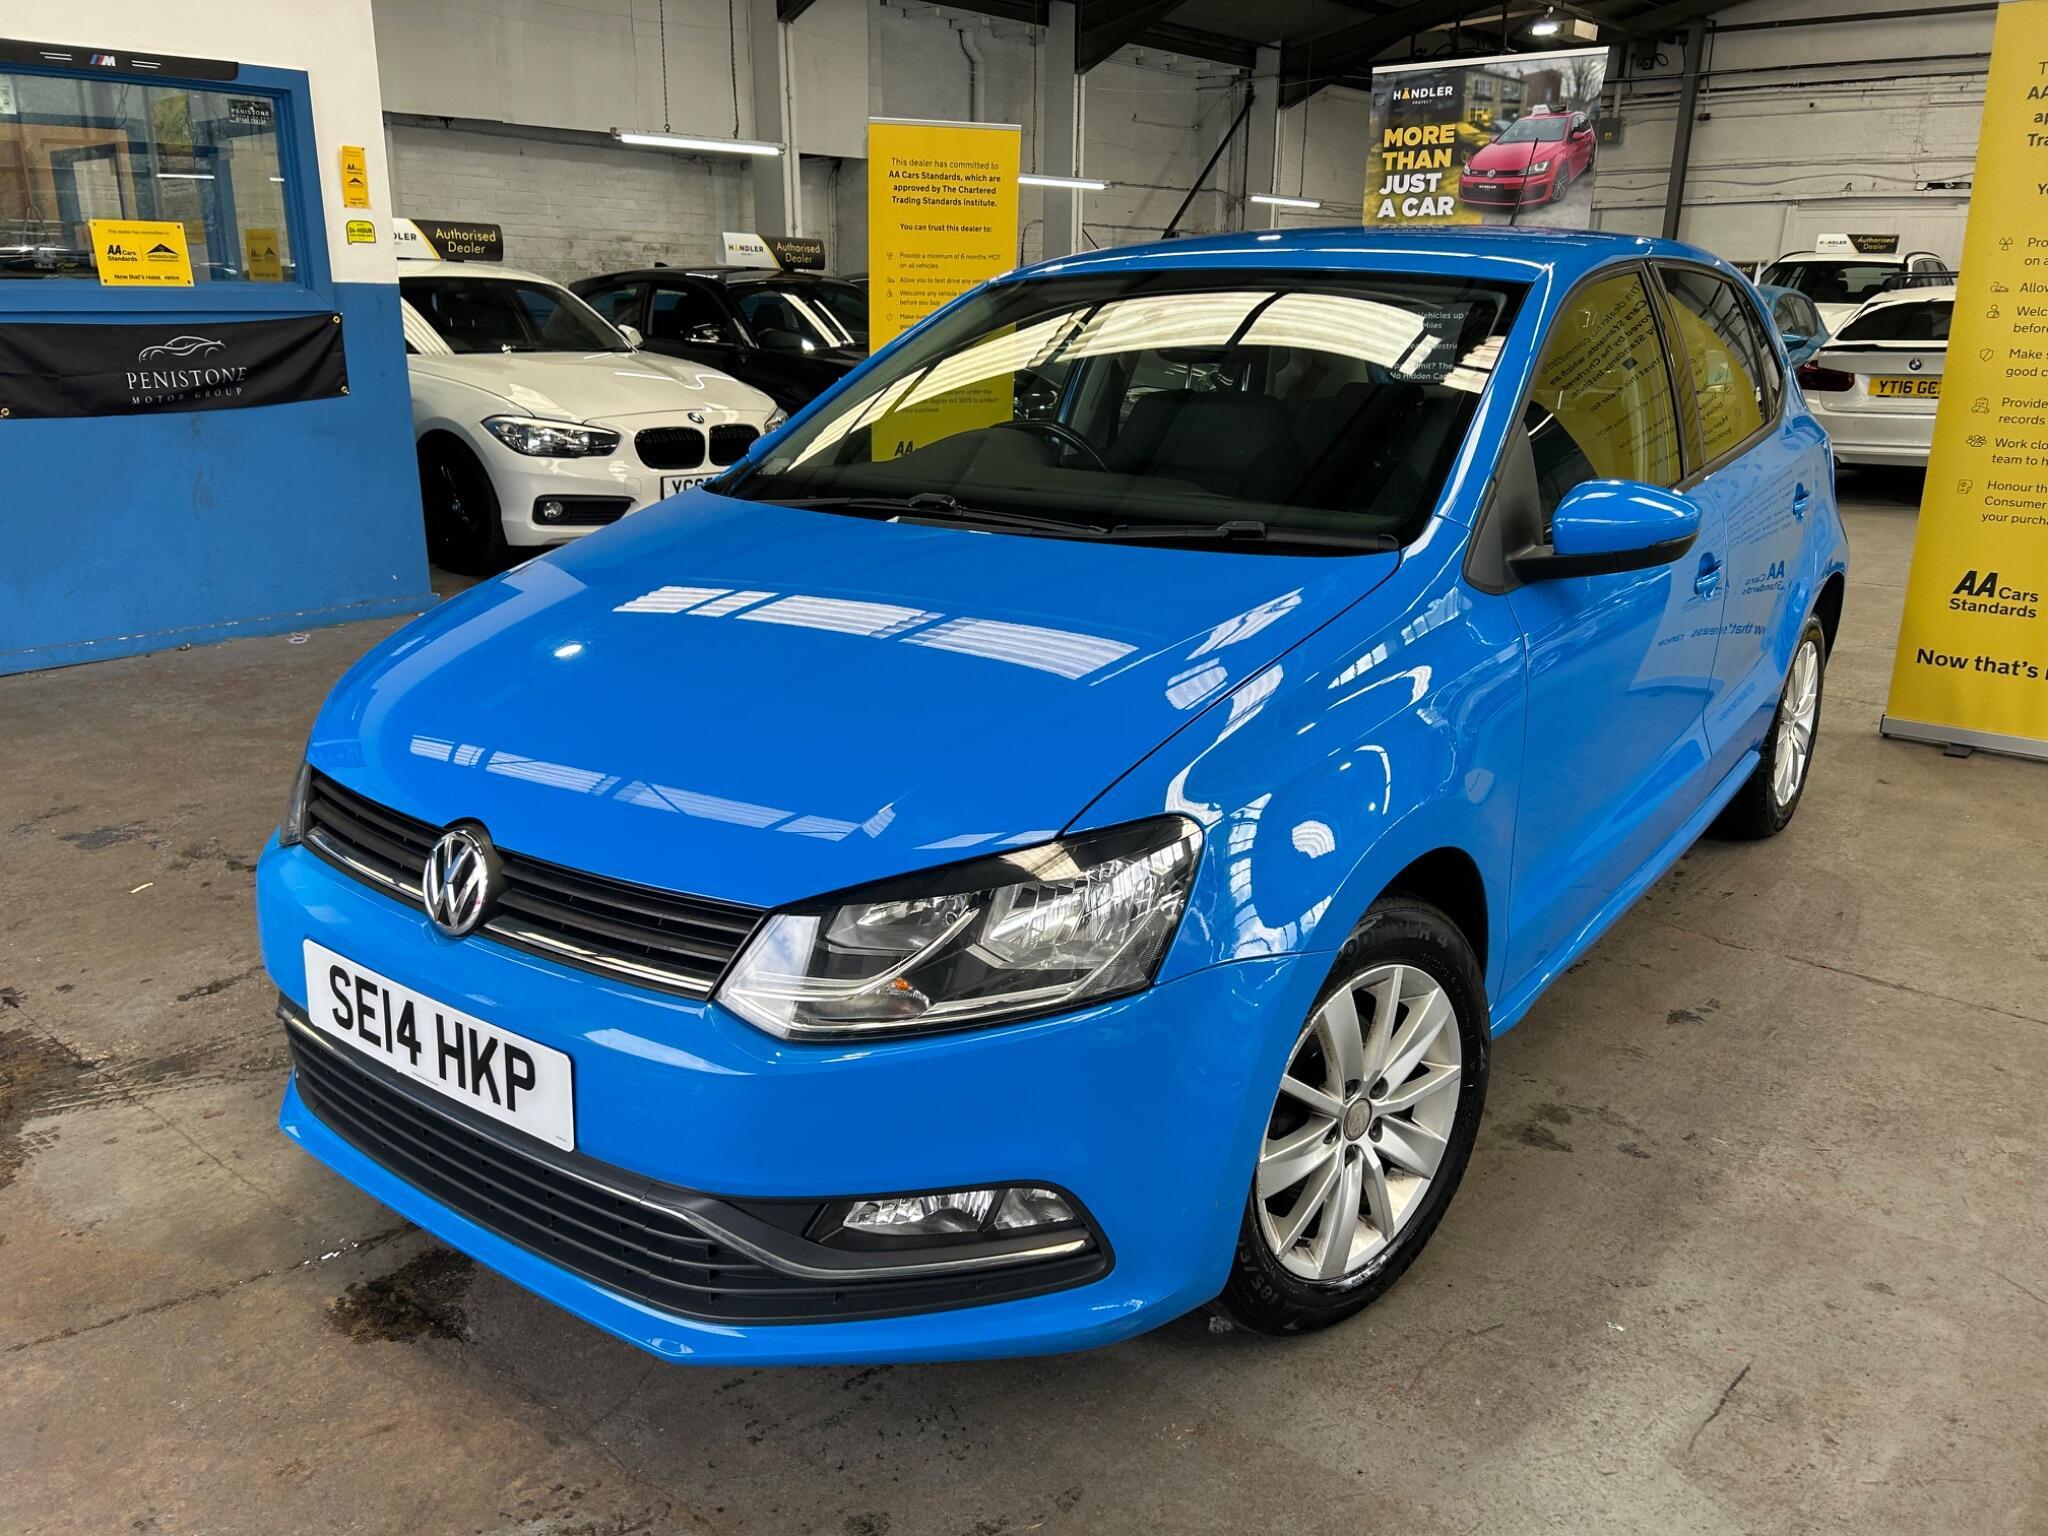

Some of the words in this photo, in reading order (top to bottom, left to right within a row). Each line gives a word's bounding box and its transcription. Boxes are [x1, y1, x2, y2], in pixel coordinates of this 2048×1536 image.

[1393, 86, 1453, 100] HANDLER
[1383, 123, 1456, 148] MORE
[891, 157, 907, 166] This
[909, 159, 932, 167] dealer
[934, 160, 948, 168] has
[949, 161, 989, 170] committed
[1382, 148, 1453, 171] THAN
[889, 170, 900, 178] AA
[901, 171, 920, 179] Cars
[921, 172, 963, 182] Standards,
[964, 174, 987, 182] which
[893, 184, 930, 192] approved
[931, 185, 941, 194] by
[942, 185, 957, 193] The
[958, 186, 997, 195] Chartered
[1379, 173, 1442, 195] JUST
[891, 196, 920, 206] Trading
[922, 197, 962, 206] Standards
[963, 198, 998, 207] Institute.
[1377, 198, 1396, 218] A
[1402, 196, 1455, 217] CAR
[900, 222, 913, 231] You
[946, 224, 959, 232] this
[435, 227, 497, 242] Authorised
[1857, 236, 1896, 244] Authorised
[448, 241, 486, 254] Dealer
[776, 241, 821, 254] Authorised
[2027, 237, 2048, 248] Pro
[107, 244, 122, 255] AA
[785, 253, 813, 264] Dealer
[2024, 257, 2040, 266] on
[1453, 313, 1464, 321] up
[2009, 348, 2043, 360] Make
[126, 367, 247, 390] PENISTONE
[2005, 367, 2038, 378] good
[1880, 380, 1913, 394] YT16
[132, 394, 184, 405] MOTOR
[195, 387, 242, 398] GROUP
[2001, 397, 2048, 409] Provide
[1998, 415, 2046, 426] records
[1995, 437, 2028, 449] Work
[1992, 453, 2022, 465] team
[2025, 455, 2038, 466] to
[1987, 480, 2033, 493] Honour
[1984, 496, 2047, 509] Consumer
[1981, 512, 2009, 523] your
[1952, 570, 1999, 598] AA
[1999, 586, 2039, 603] Cars
[1949, 598, 2038, 619] Standards
[1916, 648, 1969, 670] Now
[1974, 655, 2039, 679] that's
[328, 963, 422, 1067] SE14
[435, 1012, 537, 1113] HKP
